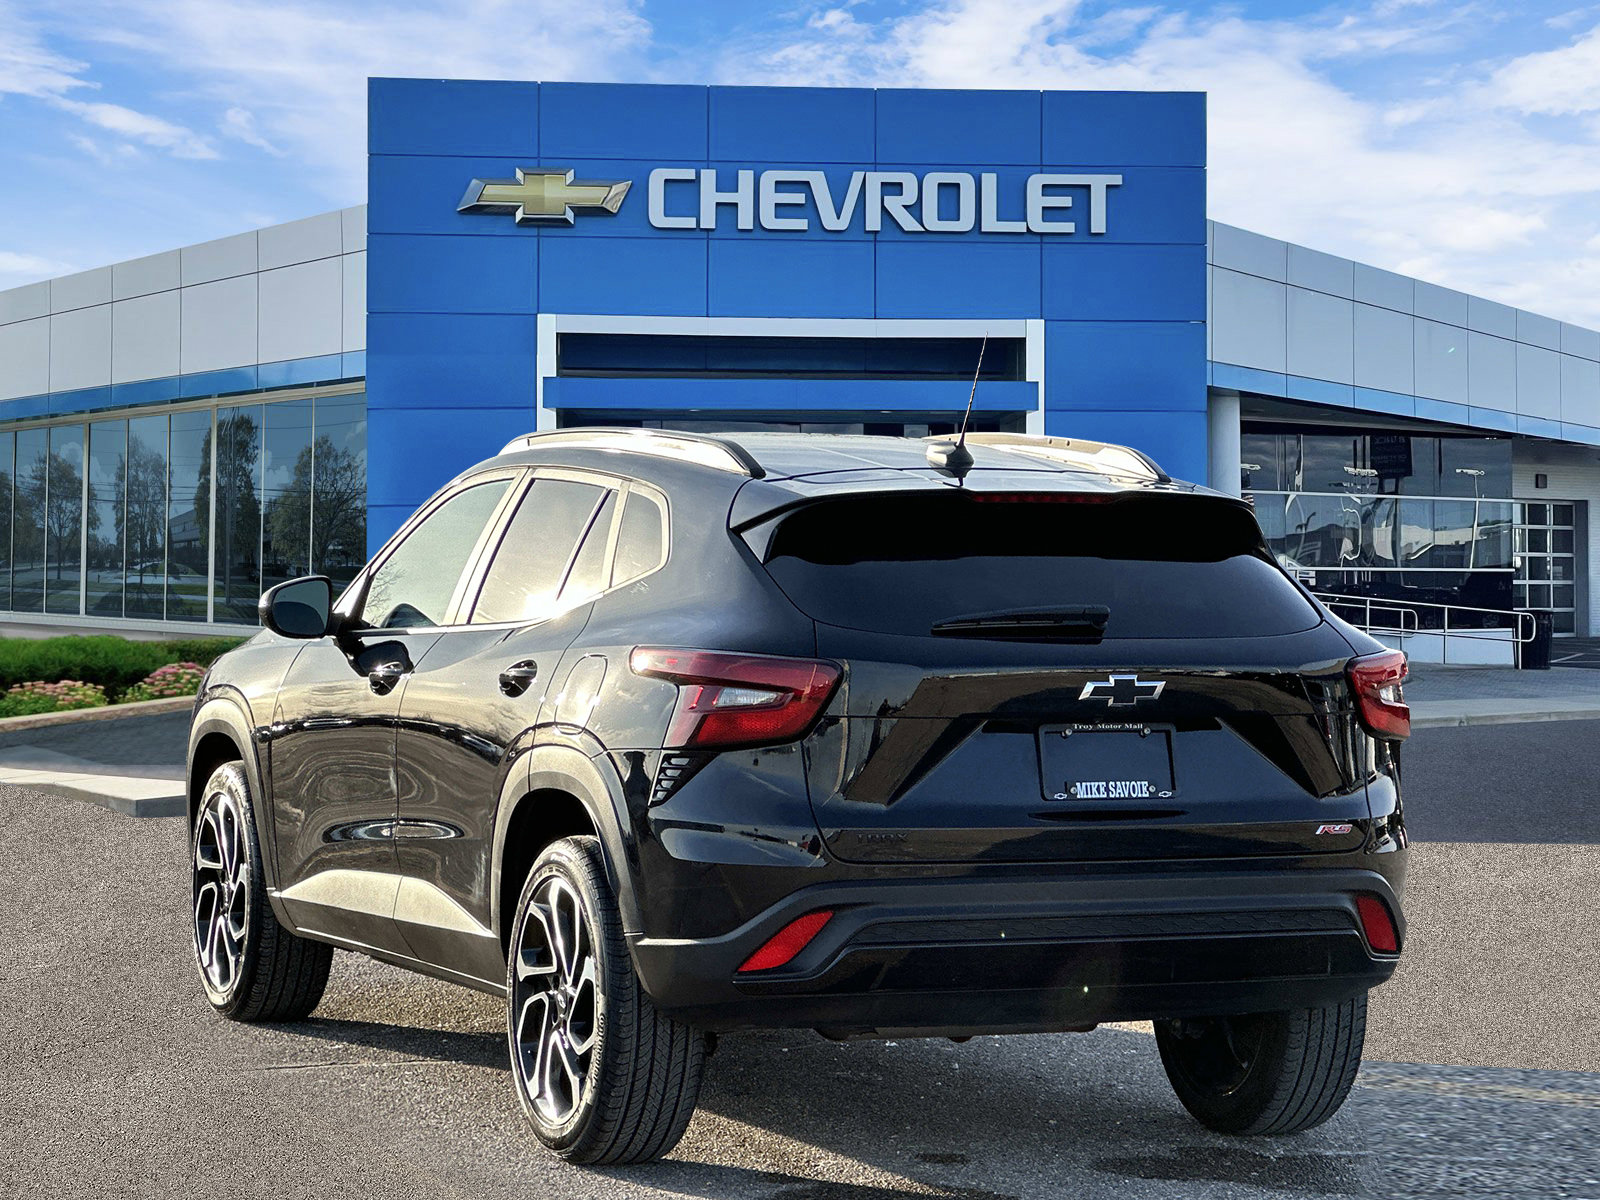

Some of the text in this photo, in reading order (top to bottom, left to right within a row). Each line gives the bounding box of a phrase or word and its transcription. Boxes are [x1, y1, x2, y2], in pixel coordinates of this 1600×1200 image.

[648, 168, 1123, 234] CHEVROLET
[1076, 781, 1149, 798] MIKE SAVOIE
[1315, 824, 1353, 835] RS
